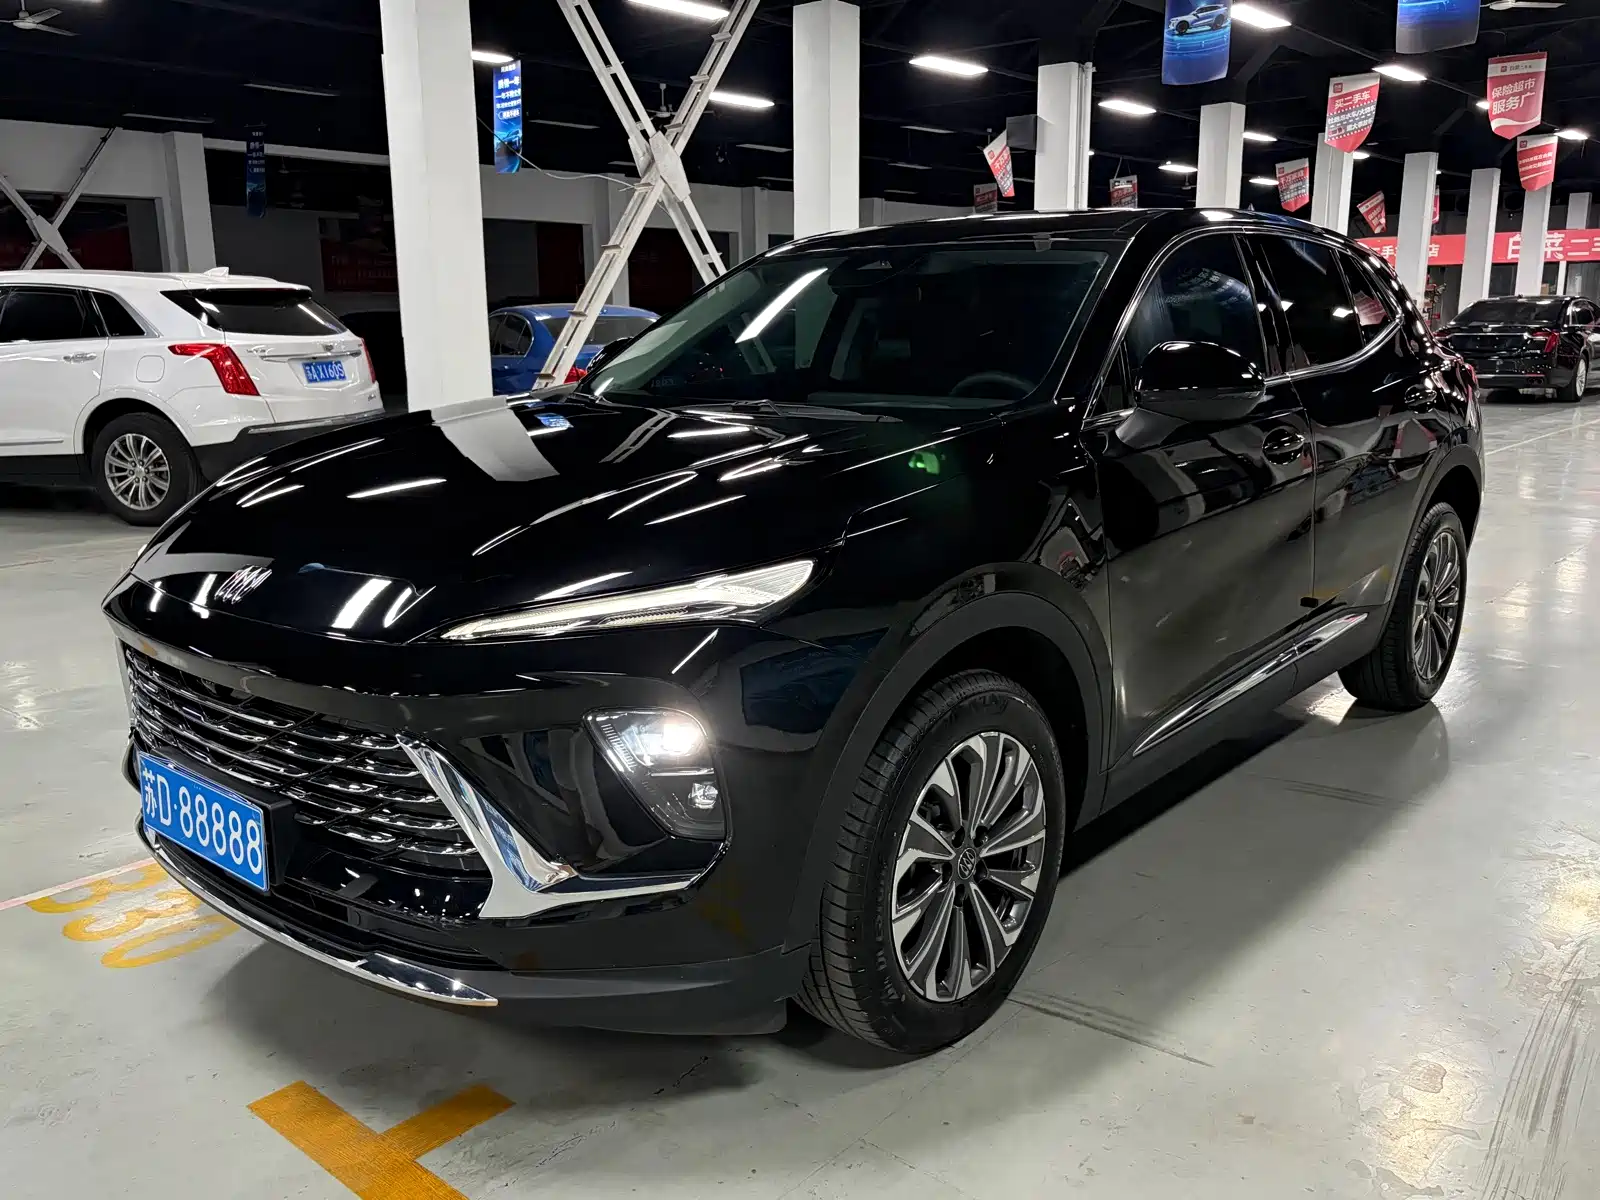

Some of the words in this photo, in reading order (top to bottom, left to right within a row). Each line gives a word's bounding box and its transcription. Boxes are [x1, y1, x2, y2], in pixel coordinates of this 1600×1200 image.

[1491, 78, 1536, 100] 保险超市
[1334, 90, 1371, 110] 买二手车
